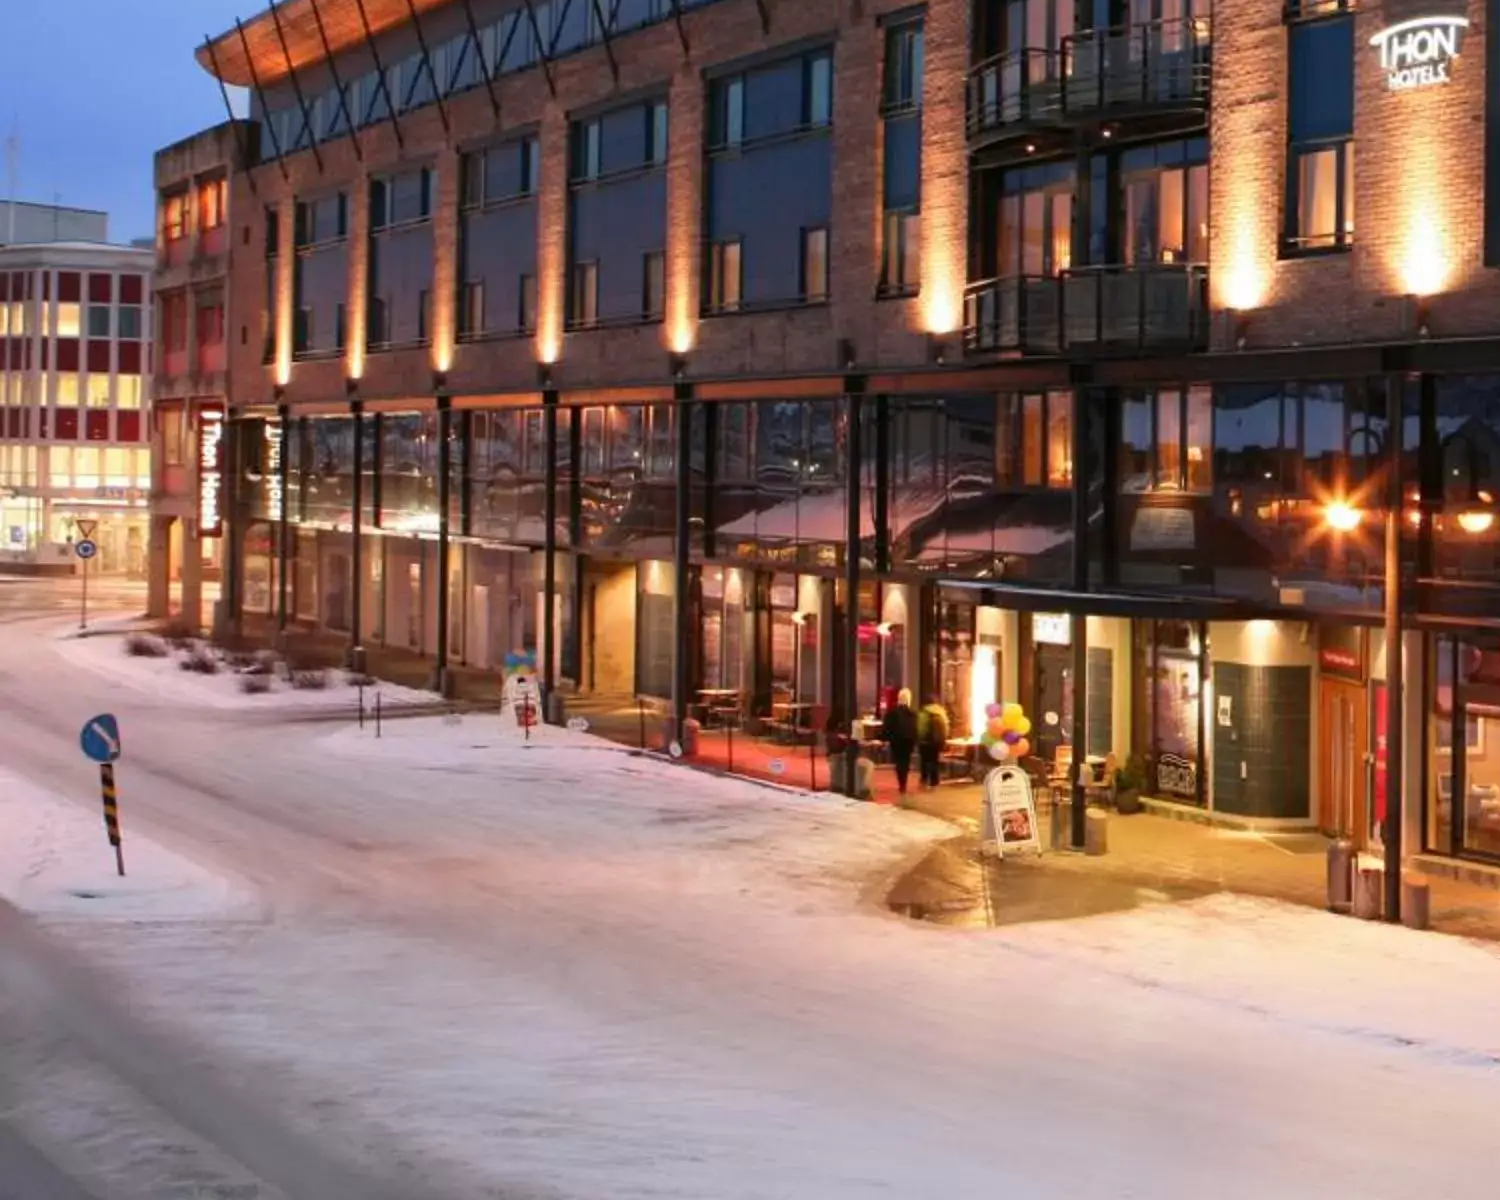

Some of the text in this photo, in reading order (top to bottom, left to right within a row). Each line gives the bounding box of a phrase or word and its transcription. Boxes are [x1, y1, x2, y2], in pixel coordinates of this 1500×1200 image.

[1368, 16, 1470, 69] THON
[1387, 63, 1448, 91] HOTELS
[201, 422, 222, 467] Thon
